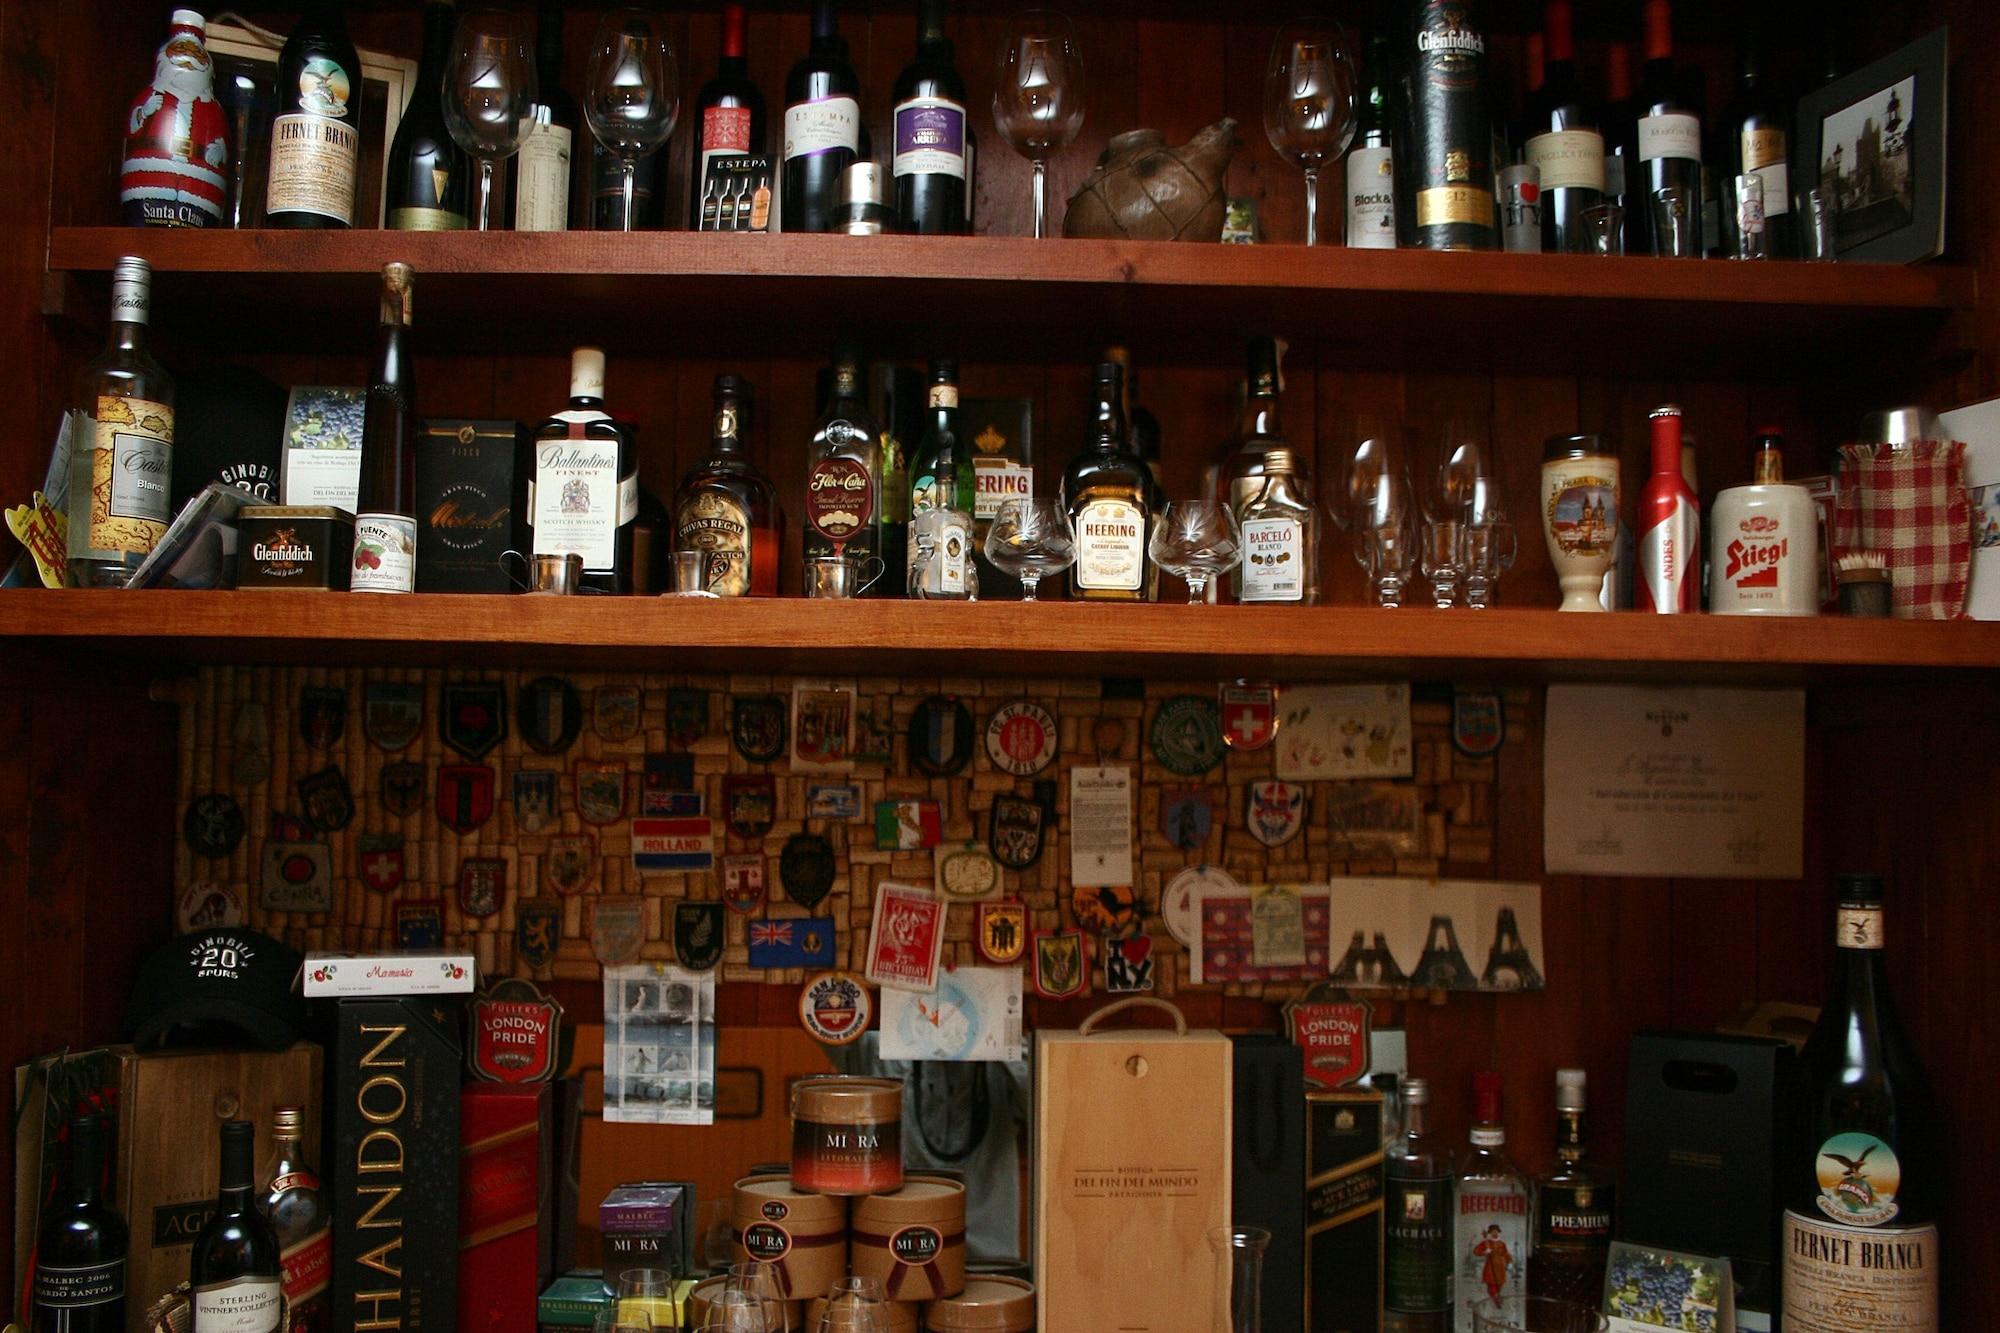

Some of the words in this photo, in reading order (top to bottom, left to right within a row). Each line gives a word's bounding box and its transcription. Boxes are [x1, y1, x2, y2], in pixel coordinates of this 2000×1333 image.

[1417, 29, 1484, 55] Glenfiddich
[281, 122, 320, 141] FERNET
[717, 159, 767, 169] ESTEPA
[143, 202, 175, 220] Santa
[539, 445, 616, 470] Ballantine's
[137, 479, 165, 493] Blanco
[811, 473, 837, 491] Flor
[844, 472, 867, 491] Caña
[976, 475, 1028, 494] ERING
[360, 526, 388, 540] PUENTE
[679, 519, 708, 538] CHIVAS
[710, 518, 744, 536] REGAL
[1086, 523, 1136, 537] HEERING
[1250, 527, 1292, 544] BARCELÓ
[253, 543, 313, 562] Glenfiddich
[1258, 543, 1282, 551] BLANCO
[1663, 539, 1674, 582] ANDES
[1726, 538, 1788, 580] Stiegl
[1007, 760, 1038, 774] 1910
[643, 840, 702, 852] HOLLAND
[190, 937, 256, 959] GINOBILI
[201, 947, 237, 969] 20
[197, 968, 239, 980] SPURS
[879, 960, 928, 978] BIRTHDAY
[1108, 958, 1152, 990] NY
[809, 979, 829, 1000] SAN
[830, 976, 861, 999] DEGO
[484, 1017, 546, 1035] LONDON
[1300, 1019, 1359, 1035] LONDON
[492, 1032, 537, 1045] PRIDE
[1308, 1034, 1352, 1047] PRIDE
[1074, 1177, 1095, 1188] DEL
[1099, 1177, 1120, 1187] FIN
[1123, 1177, 1145, 1187] DEL
[1148, 1177, 1198, 1188] MUNDO
[1461, 1193, 1526, 1216] BEEFEATER
[1551, 1214, 1610, 1228] PREMIUM
[1794, 1227, 1852, 1266] FERNET
[1860, 1241, 1923, 1270] BRANCA
[70, 1283, 114, 1298] SANTOS
[219, 1291, 267, 1306] STERLING
[199, 1305, 239, 1314] VINTNER'S
